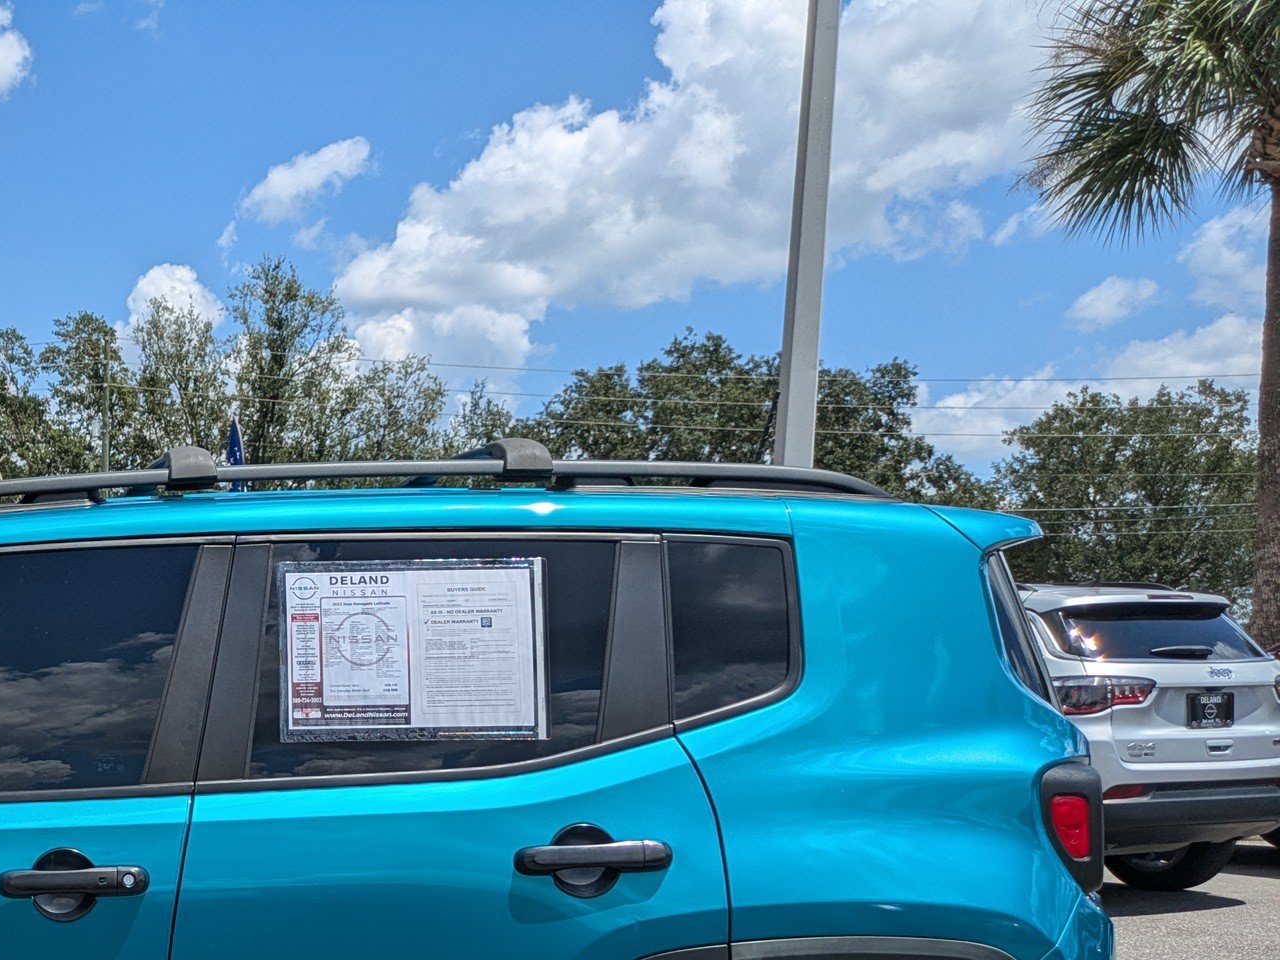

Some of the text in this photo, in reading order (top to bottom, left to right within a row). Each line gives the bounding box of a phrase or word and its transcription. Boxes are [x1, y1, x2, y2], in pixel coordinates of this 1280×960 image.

[329, 575, 390, 586] DELAND
[329, 635, 398, 645] NISSAN
[1200, 696, 1222, 704] DELAND
